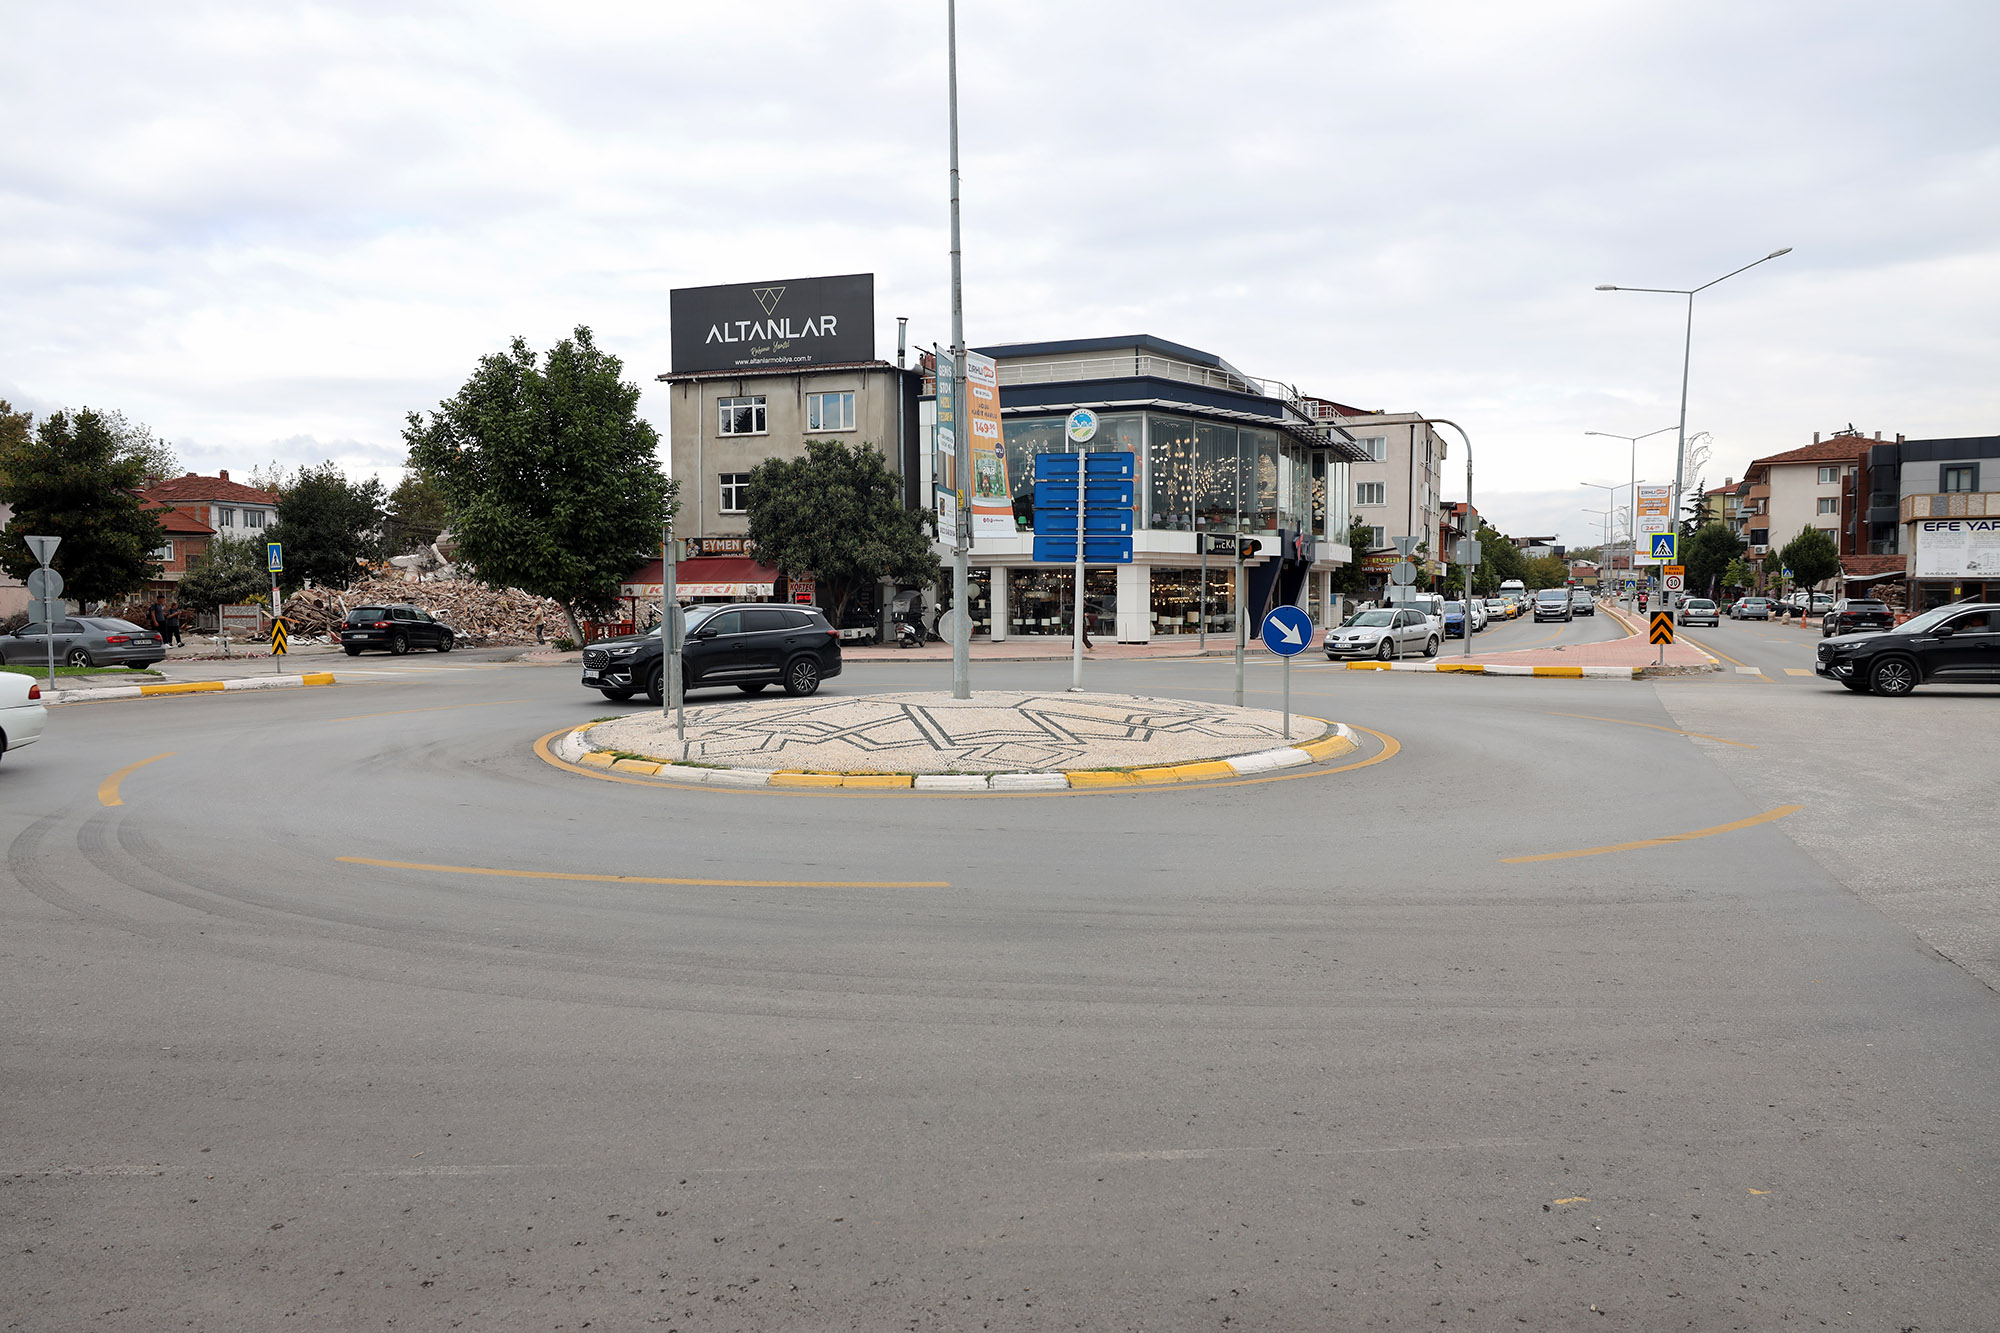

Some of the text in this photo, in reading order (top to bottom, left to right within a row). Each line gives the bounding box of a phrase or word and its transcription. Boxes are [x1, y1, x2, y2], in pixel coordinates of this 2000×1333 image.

[705, 315, 837, 344] ALTANLAR
[734, 355, 812, 365] www.altanlarmobilya.com.tr
[1923, 521, 1961, 532] EFE
[702, 539, 741, 551] EYMEN
[1669, 579, 1678, 587] 30
[649, 584, 732, 595] KFTECİ
